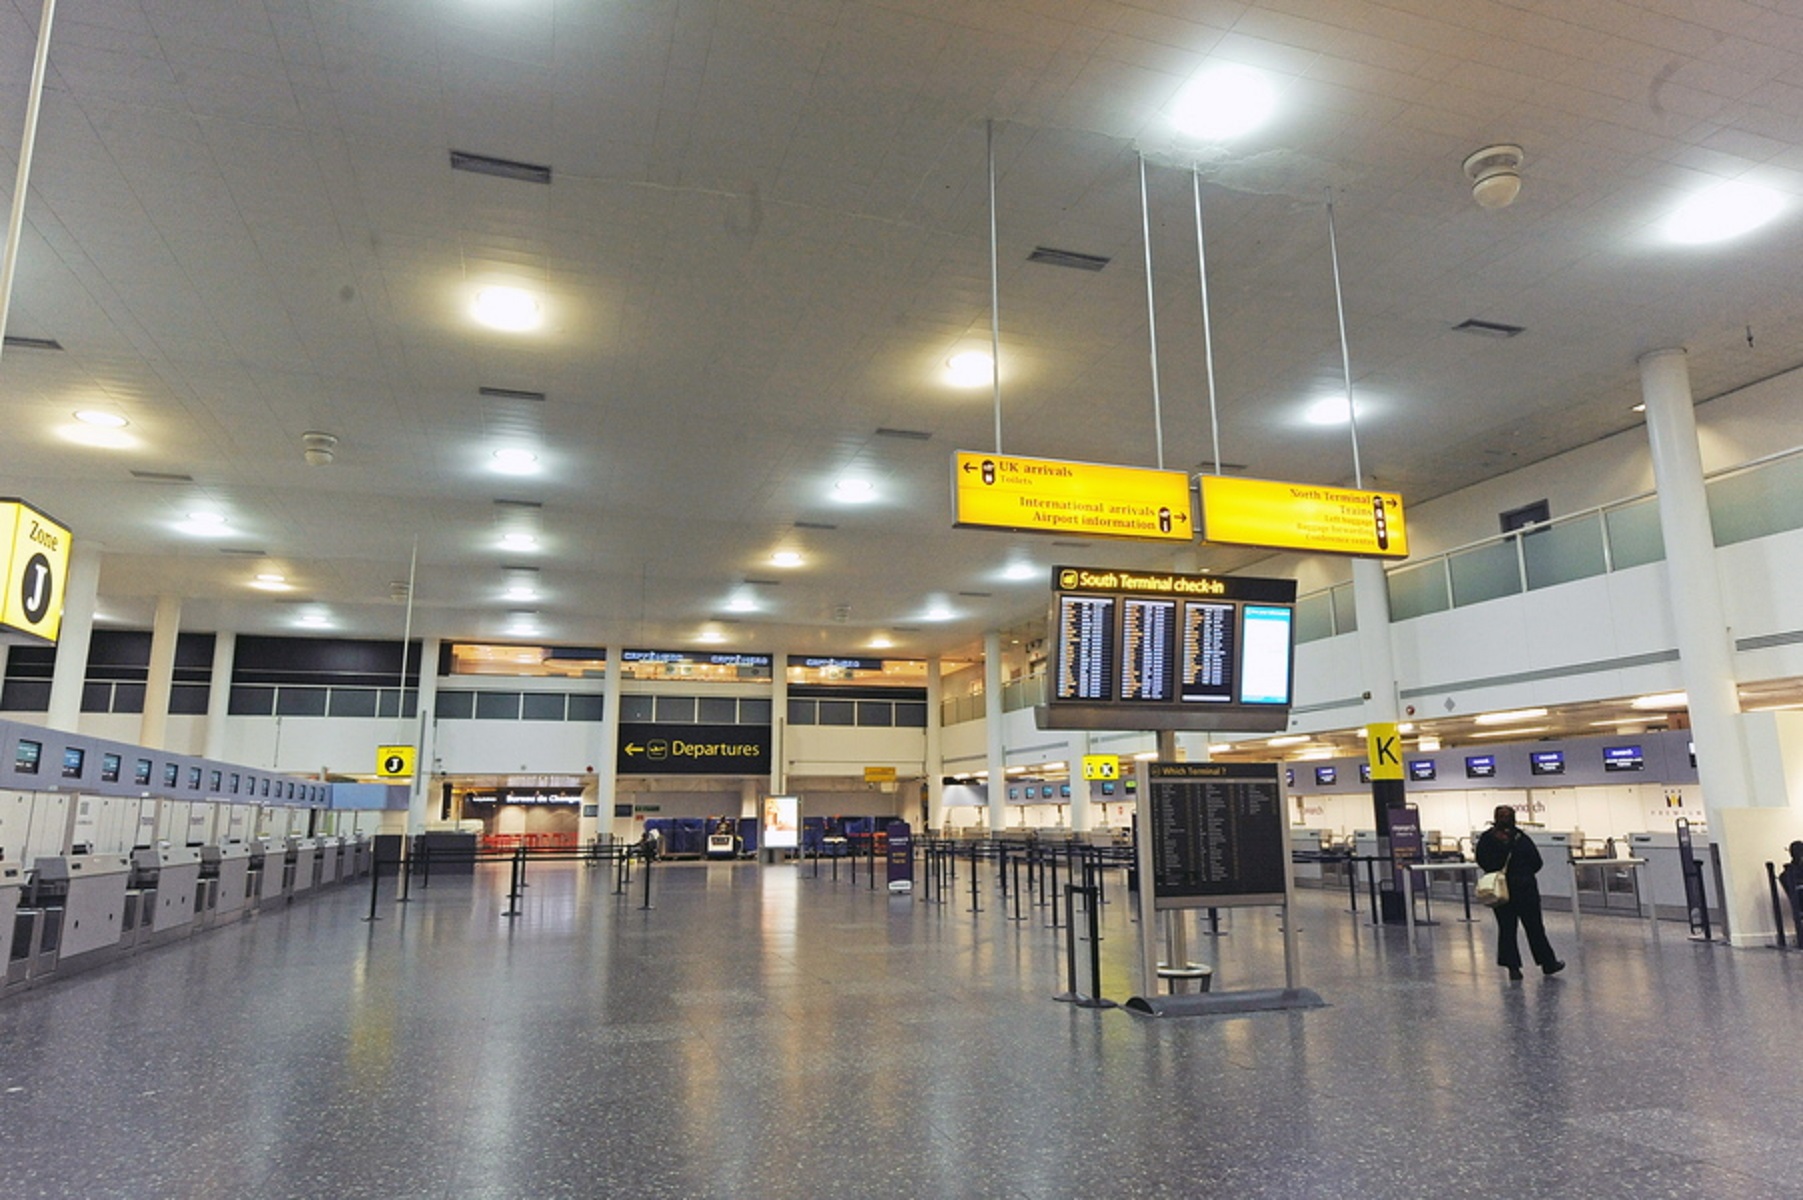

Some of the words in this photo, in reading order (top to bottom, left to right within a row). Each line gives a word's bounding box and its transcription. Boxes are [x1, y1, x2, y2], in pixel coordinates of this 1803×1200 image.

[1000, 461, 1019, 473] UK
[1024, 463, 1073, 477] arrivals
[1001, 474, 1033, 485] Toilets
[1290, 488, 1321, 500] North
[1324, 491, 1371, 504] Terminal
[1020, 496, 1106, 513] International
[1109, 504, 1156, 517] arrivals
[1340, 505, 1373, 516] Trains
[1033, 511, 1080, 527] Airport
[1082, 515, 1156, 530] information
[29, 520, 59, 552] Zone
[26, 563, 49, 612] J
[1080, 572, 1118, 589] South
[1120, 574, 1172, 591] Terminal
[1174, 577, 1225, 594] check-in
[672, 740, 760, 759] Departures
[1376, 736, 1399, 766] K
[388, 758, 400, 772] J
